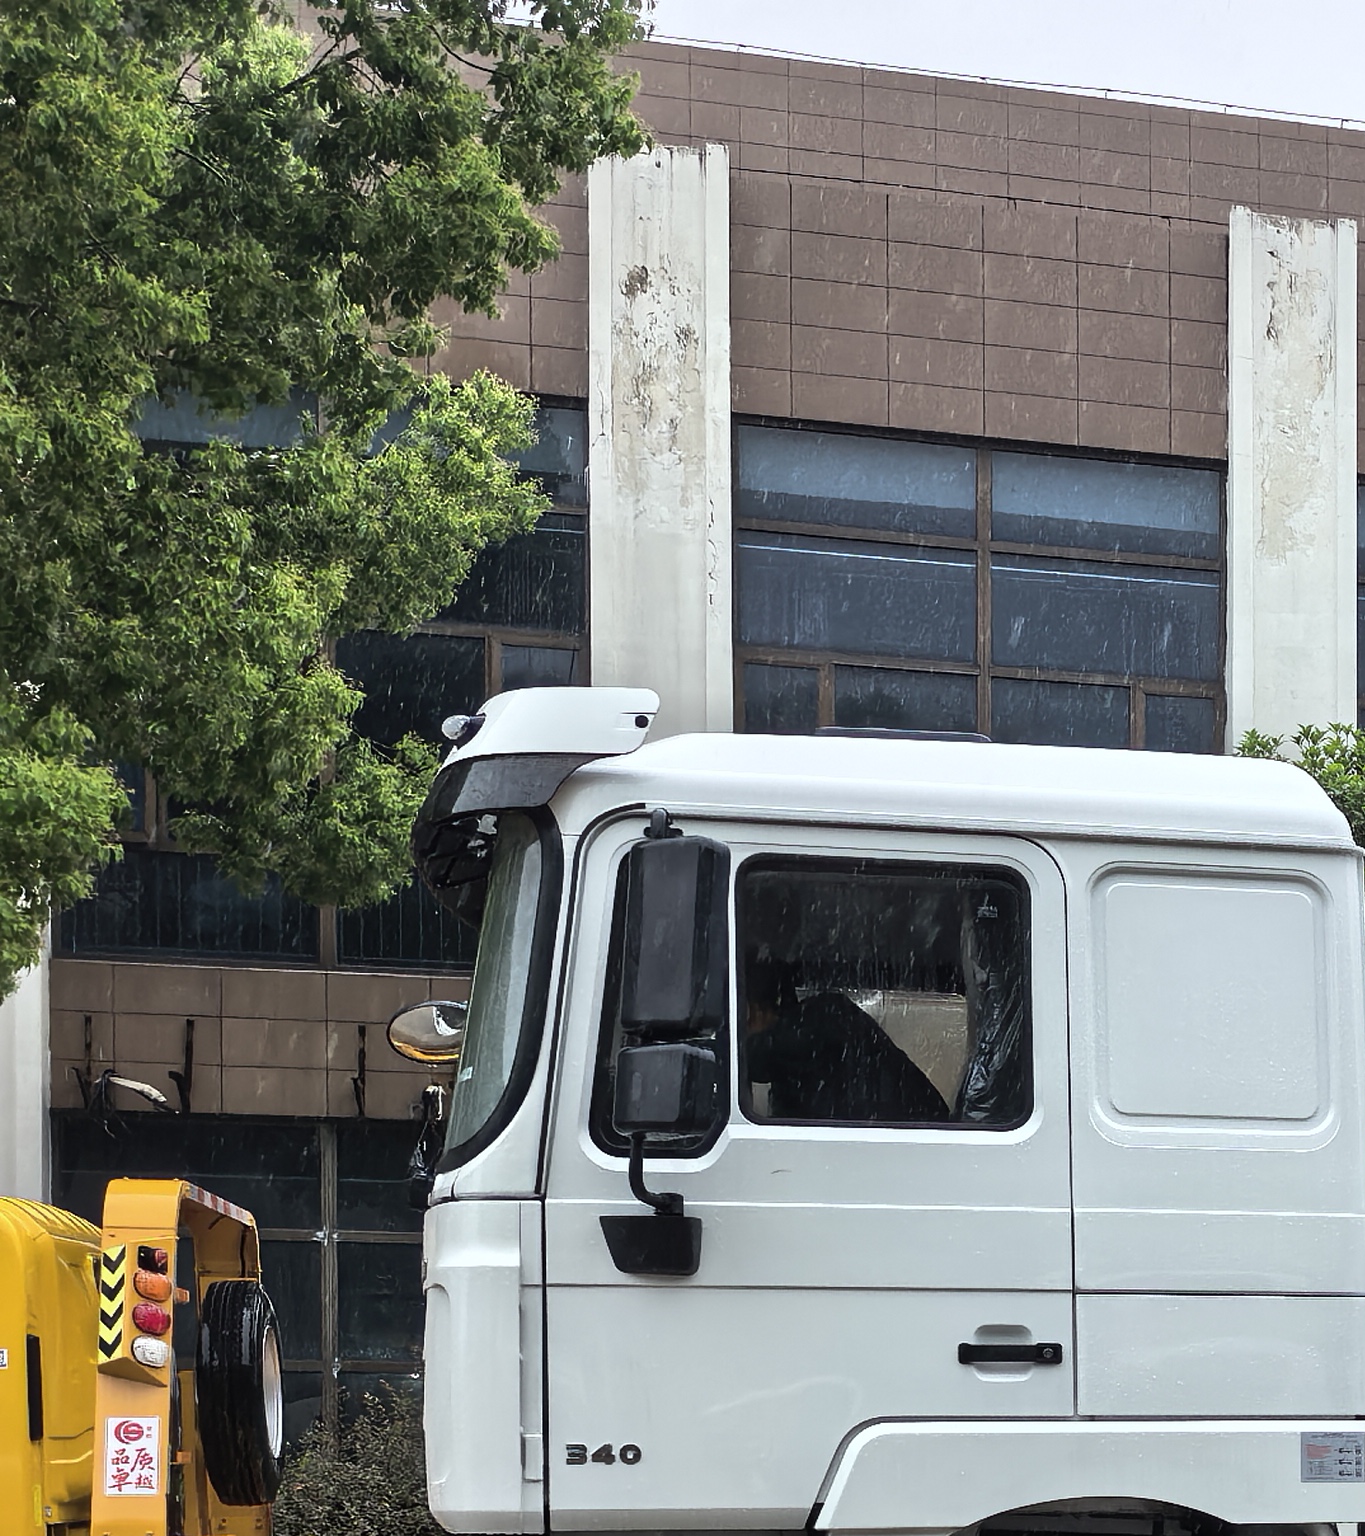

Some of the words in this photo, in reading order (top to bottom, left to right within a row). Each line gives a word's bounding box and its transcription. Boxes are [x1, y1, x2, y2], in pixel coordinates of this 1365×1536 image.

[111, 1448, 155, 1472] 品质
[565, 1443, 642, 1466] 340
[108, 1467, 155, 1492] 卓越
